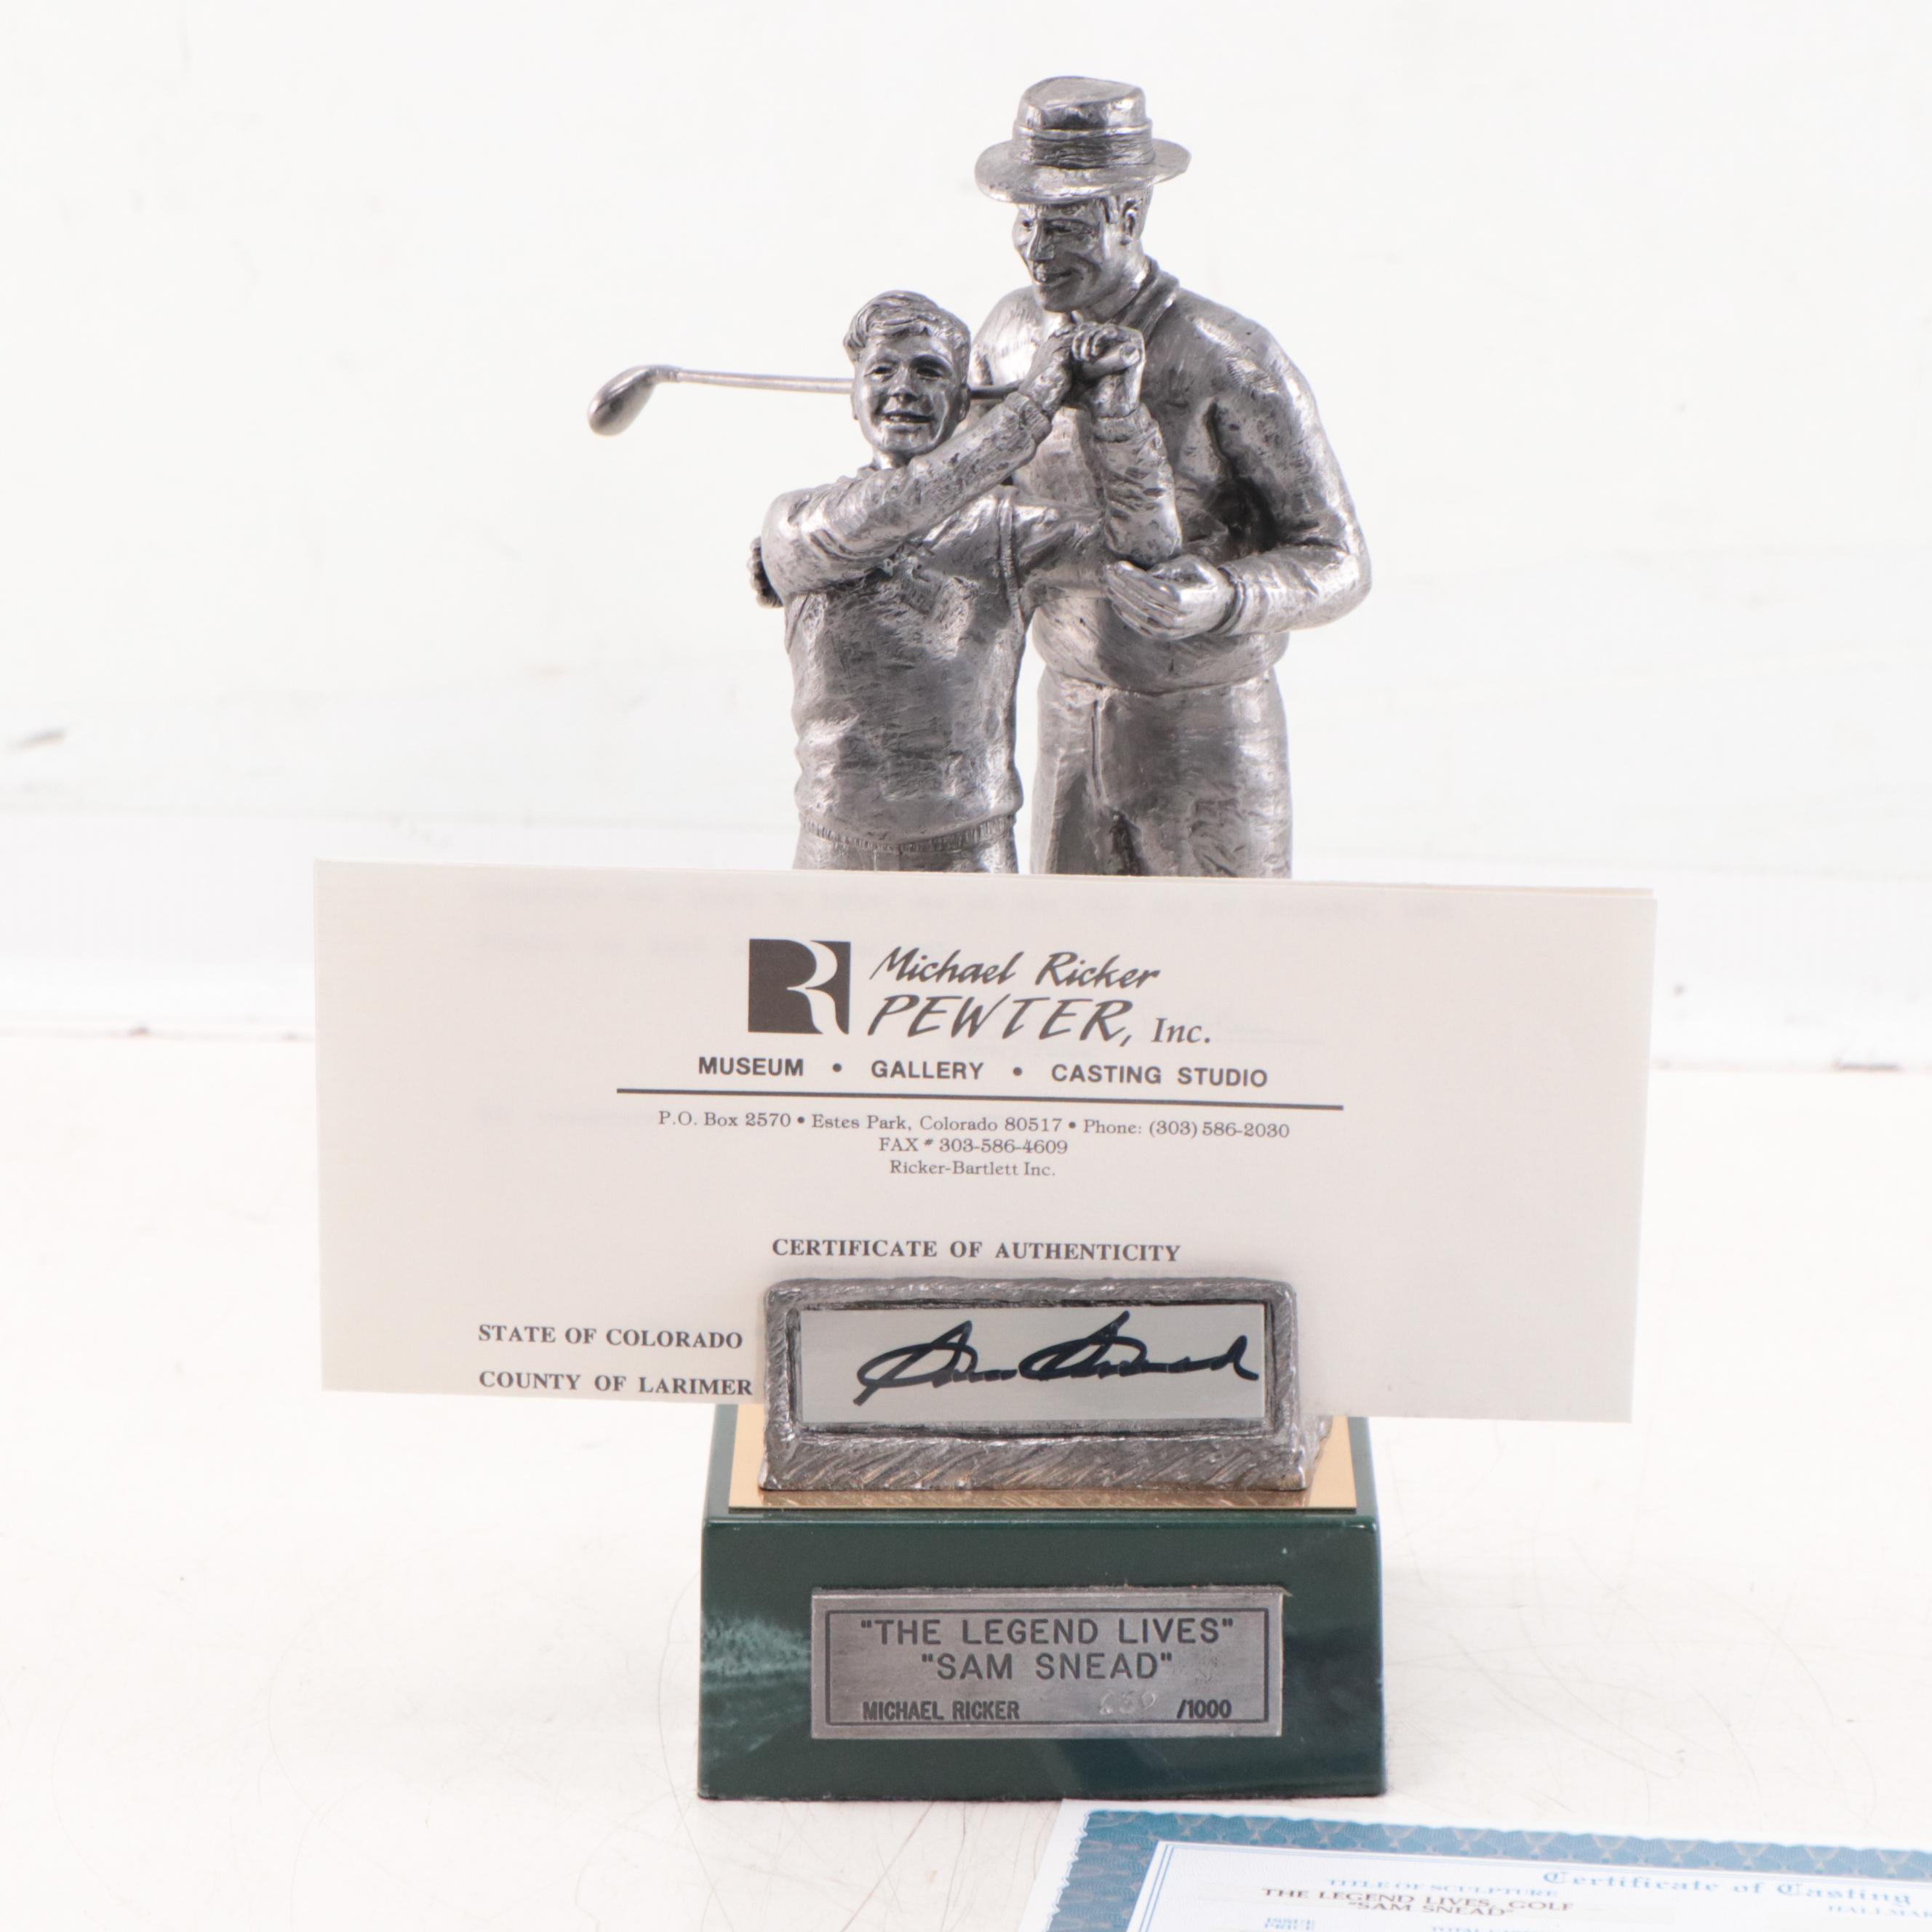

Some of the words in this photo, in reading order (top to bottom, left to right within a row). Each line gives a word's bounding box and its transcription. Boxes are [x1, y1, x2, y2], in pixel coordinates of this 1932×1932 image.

[871, 949, 1023, 983] Michael
[1035, 951, 1160, 989] Ricker
[868, 994, 1133, 1047] PEWTER,
[1151, 1018, 1210, 1043] Inc.
[699, 1057, 803, 1076] MUSEUM
[871, 1060, 983, 1079] GALLERY
[1052, 1064, 1161, 1084] CASTING
[1178, 1067, 1267, 1087] STUDIO
[660, 1111, 698, 1125] P.O.
[705, 1112, 738, 1126] Box
[746, 1113, 791, 1127] 2570
[813, 1114, 859, 1128] Estes
[868, 1115, 911, 1130] Park,
[920, 1116, 997, 1130] Colorado
[1005, 1117, 1061, 1131] 80517
[1085, 1119, 1142, 1133] Phone:
[1150, 1121, 1197, 1137] (303)
[1202, 1122, 1289, 1137] 586-2030
[880, 1138, 918, 1151] FAX
[940, 1138, 1067, 1153] 303-586-4609
[890, 1160, 1016, 1175] Ricker-Bartlett
[1025, 1162, 1055, 1176] Inc.
[773, 1240, 937, 1257] CERTIFICATE
[950, 1241, 982, 1257] OF
[996, 1242, 1180, 1261] AUTHENTICITY
[479, 1325, 555, 1342] STATE
[565, 1328, 596, 1344] OF
[607, 1329, 743, 1349] COLORADO
[479, 1372, 580, 1389] COUNTY
[595, 1376, 626, 1391] OF
[639, 1377, 753, 1395] LARIMER
[861, 1619, 941, 1645] "THE
[962, 1618, 1098, 1645] LEGEND
[1119, 1618, 1233, 1644] LIVES"
[922, 1653, 1012, 1680] "SAM
[1036, 1653, 1172, 1680] SNEAD"
[863, 1701, 944, 1720] MICHAEL
[951, 1701, 1020, 1720] RICKER
[1176, 1699, 1232, 1719] /1000
[1263, 1888, 1310, 1899] THE
[1318, 1891, 1415, 1904] LEGEND
[1508, 1899, 1576, 1912] GOLF
